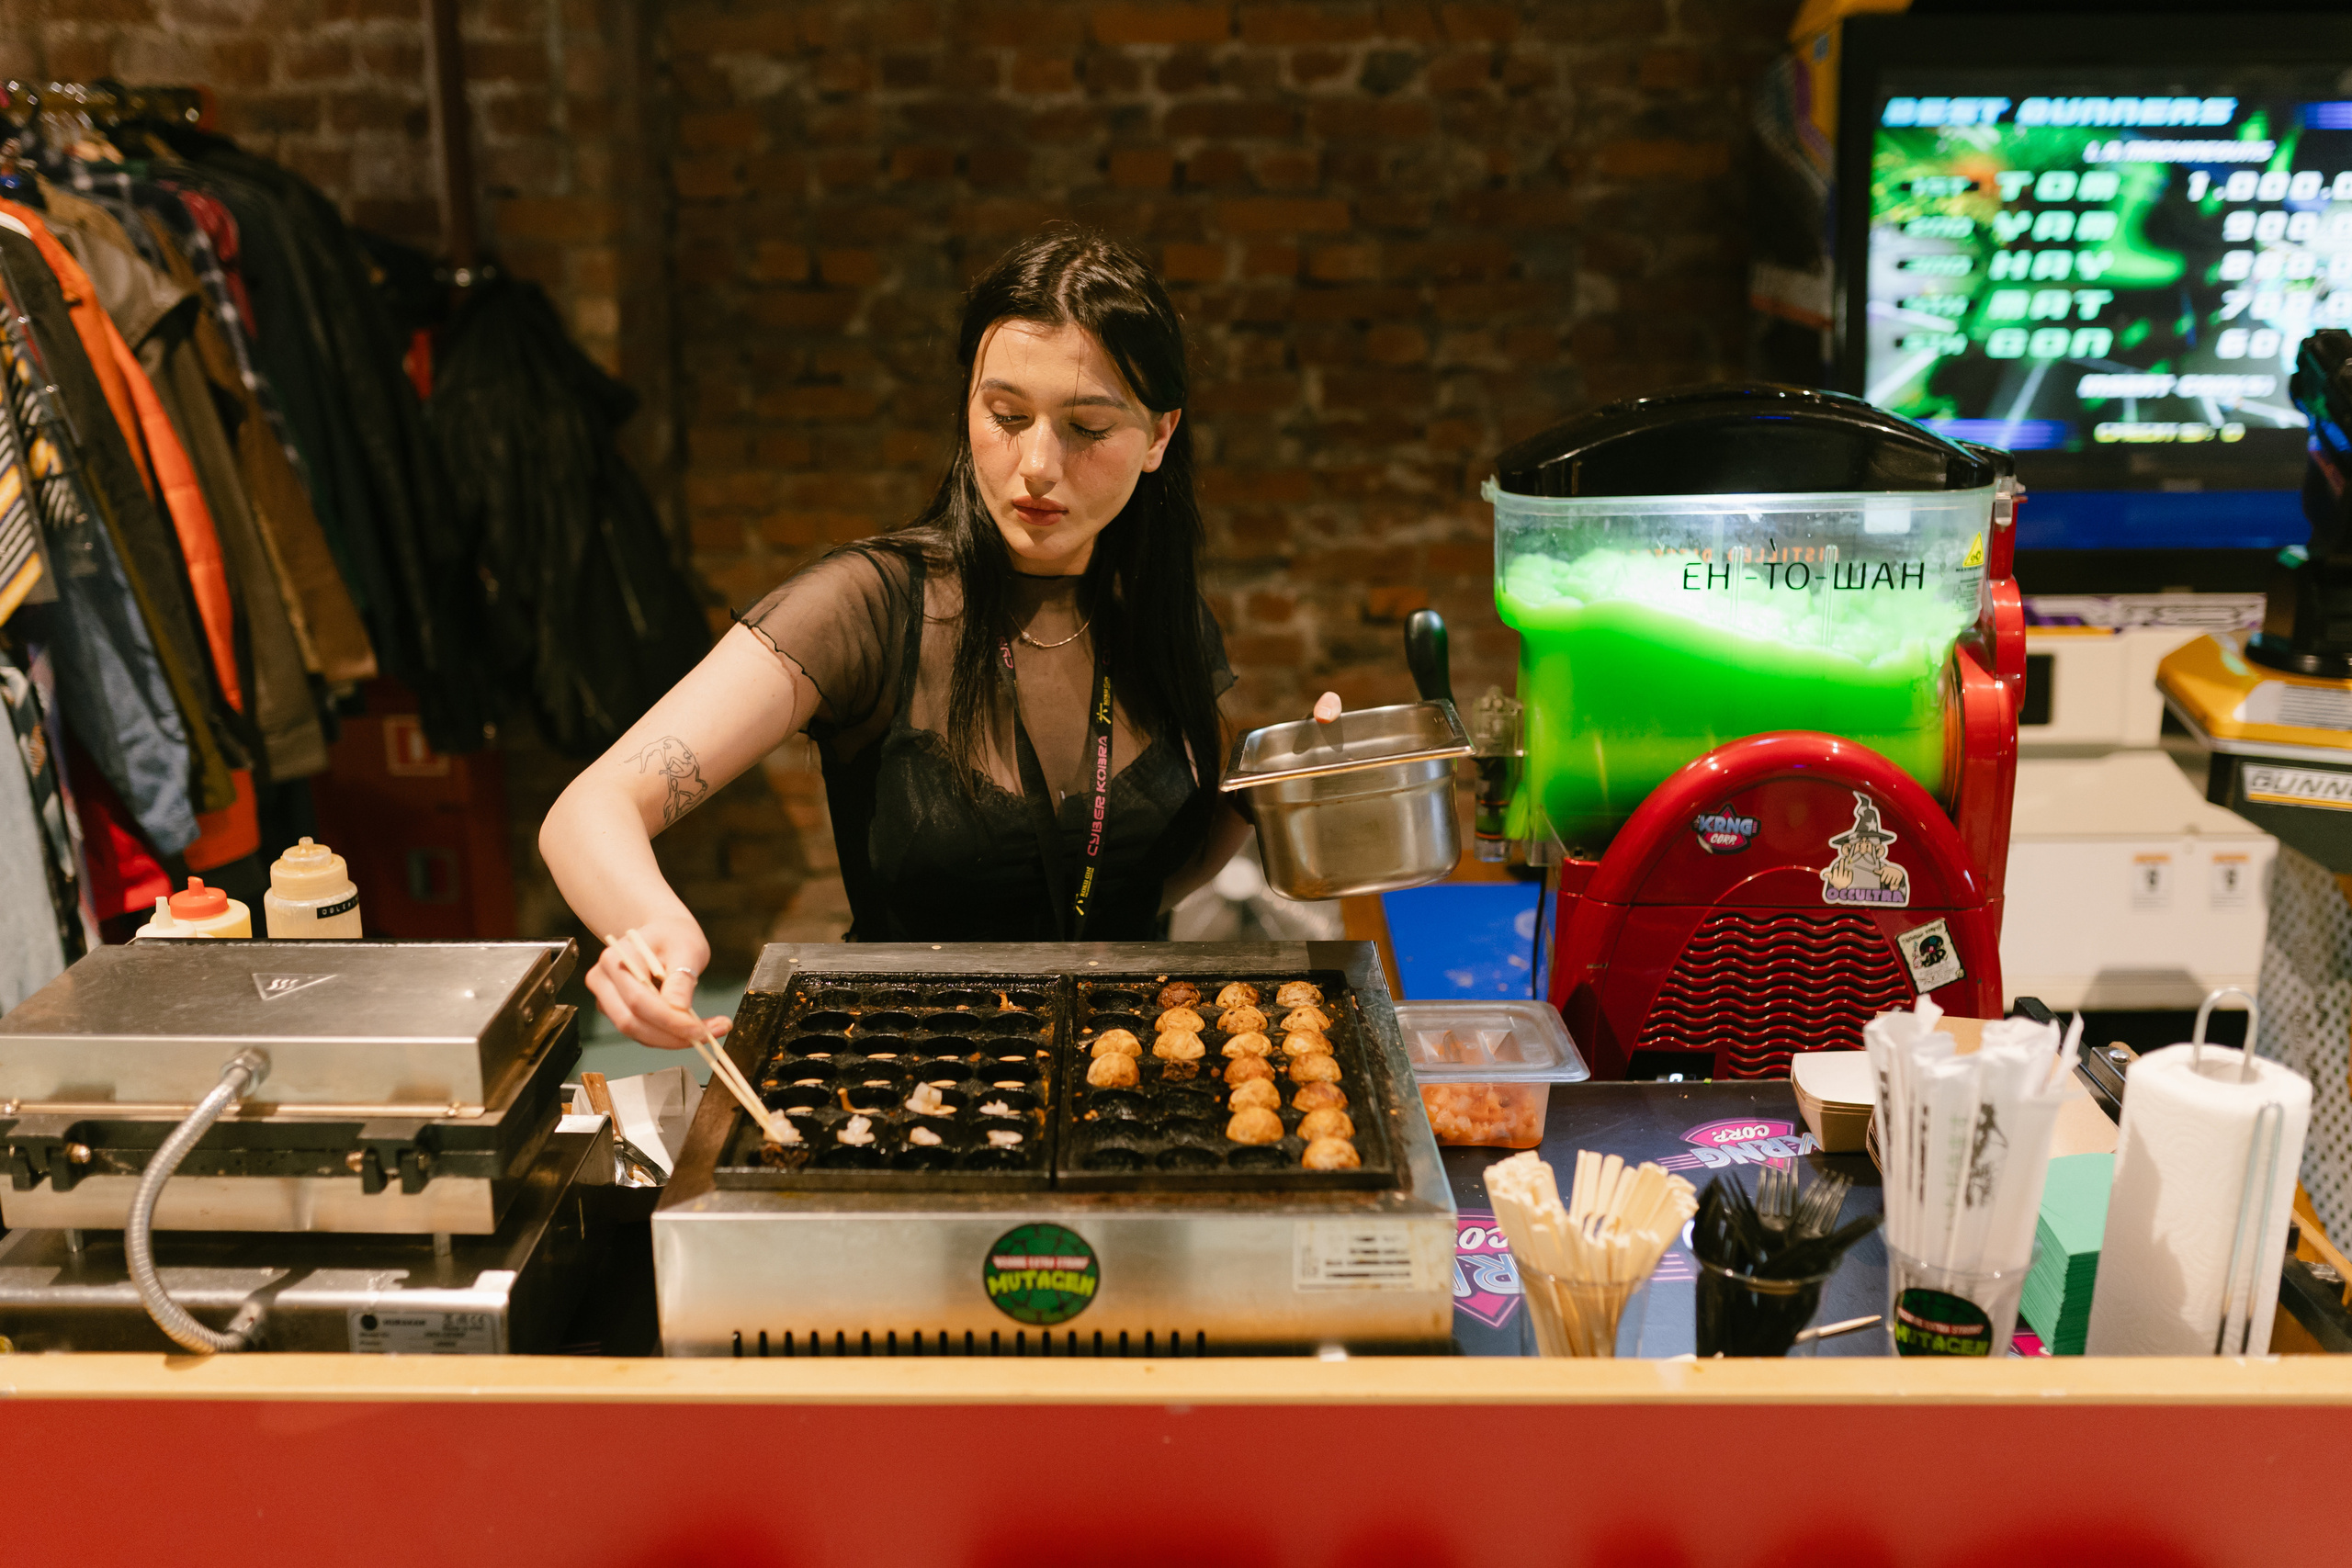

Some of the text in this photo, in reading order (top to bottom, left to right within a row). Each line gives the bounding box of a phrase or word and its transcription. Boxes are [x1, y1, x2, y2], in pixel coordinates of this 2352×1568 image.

[2251, 773, 2352, 795] GUNN
[1087, 795, 1105, 856] CYBER
[1699, 815, 1753, 836] KRNG
[1826, 887, 1905, 902] OCCULTRA
[1690, 1132, 1822, 1169] KRNG
[988, 1269, 1096, 1296] MUTAGEN
